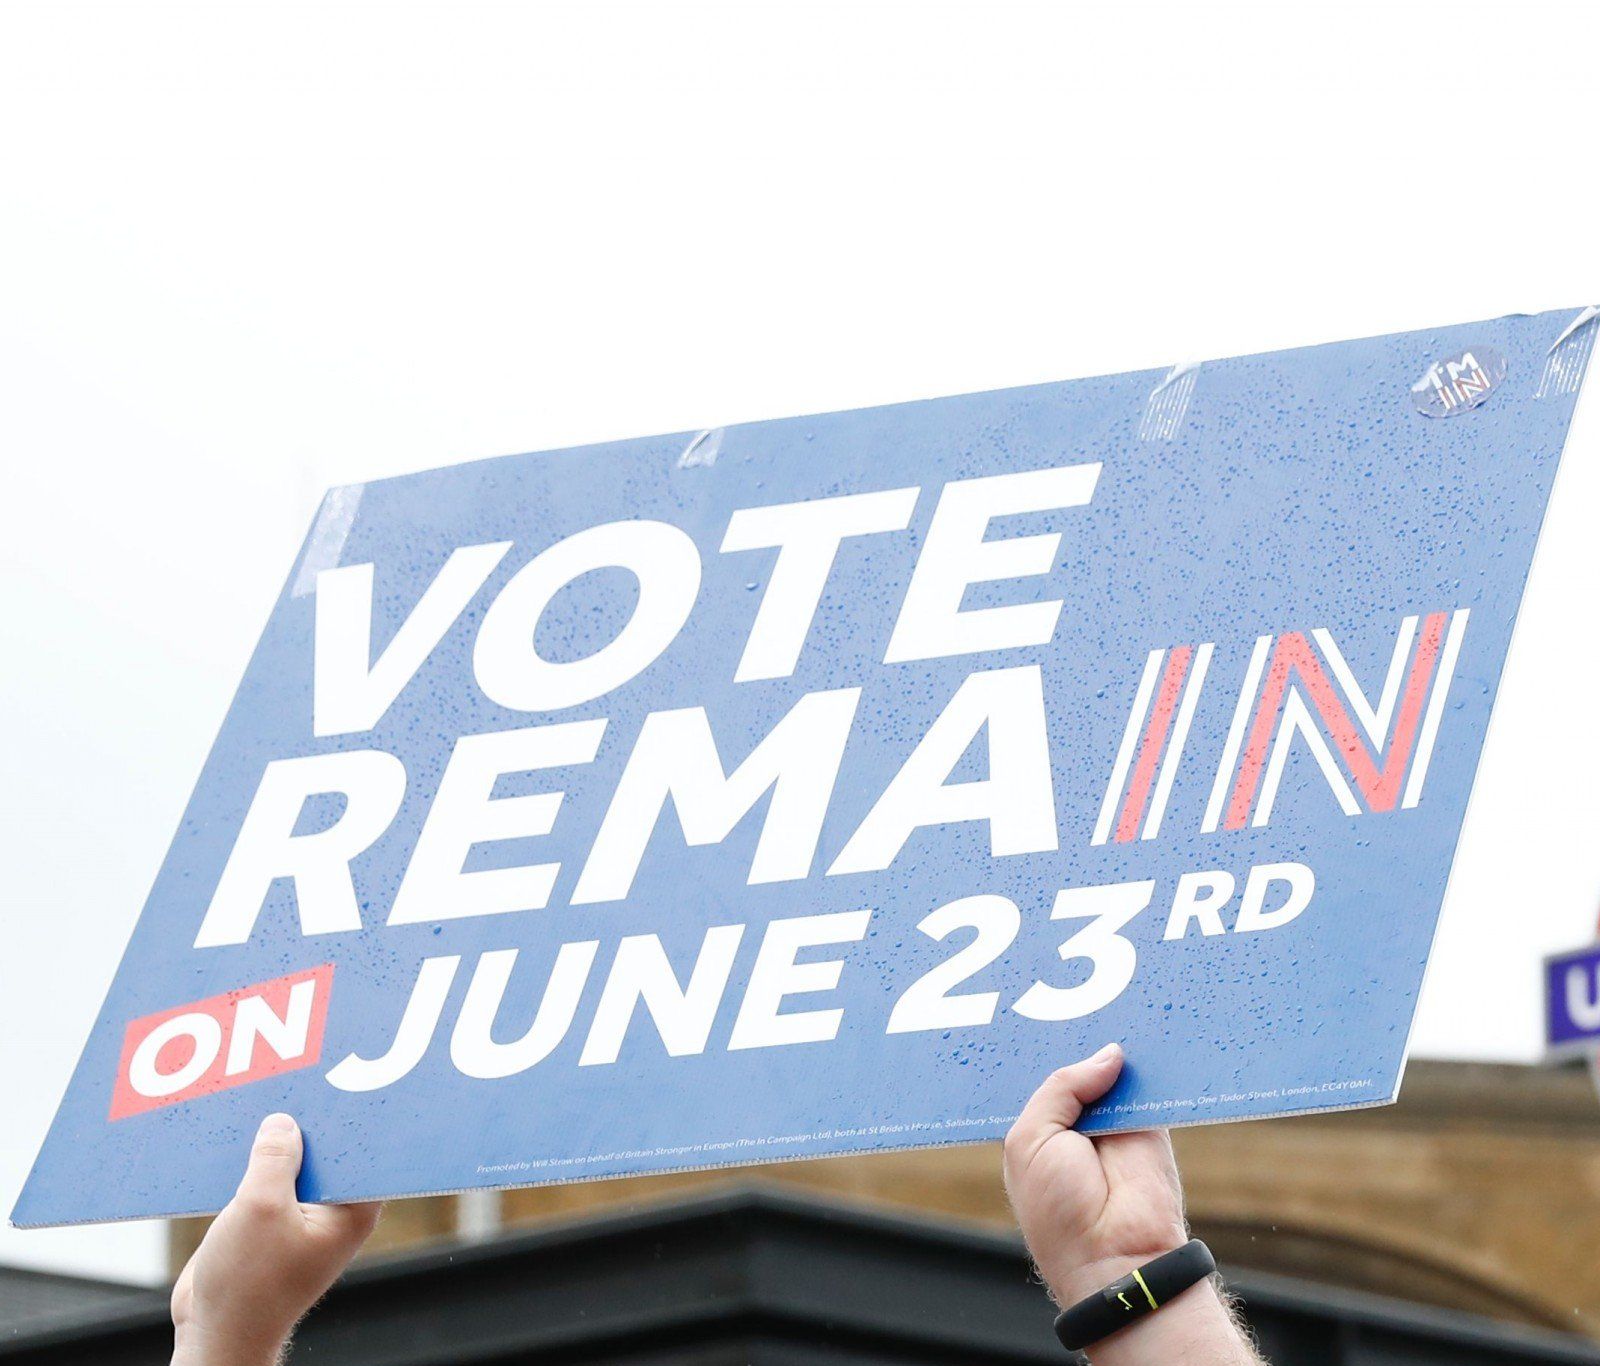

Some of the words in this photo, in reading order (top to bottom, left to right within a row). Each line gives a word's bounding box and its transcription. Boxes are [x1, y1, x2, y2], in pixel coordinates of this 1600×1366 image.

[313, 461, 1103, 737] VOTE
[193, 607, 1470, 948] REMAIN
[128, 979, 316, 1098] ON
[325, 910, 872, 1092] JUNE
[476, 1162, 519, 1173] Promoted
[532, 1159, 548, 1169] Will
[549, 1158, 574, 1167] Straw
[587, 1153, 614, 1164] behalf
[625, 1150, 653, 1160] Britain
[654, 1146, 693, 1155] Stronger
[703, 1142, 735, 1151] Europe
[767, 1134, 811, 1145] Campaign
[834, 1128, 857, 1138] both
[879, 1123, 909, 1133] Bride's
[945, 1117, 987, 1128] Salisbury
[1114, 1102, 1149, 1113] Printed
[1197, 1096, 1217, 1104] One
[1220, 1093, 1245, 1102] Tudor
